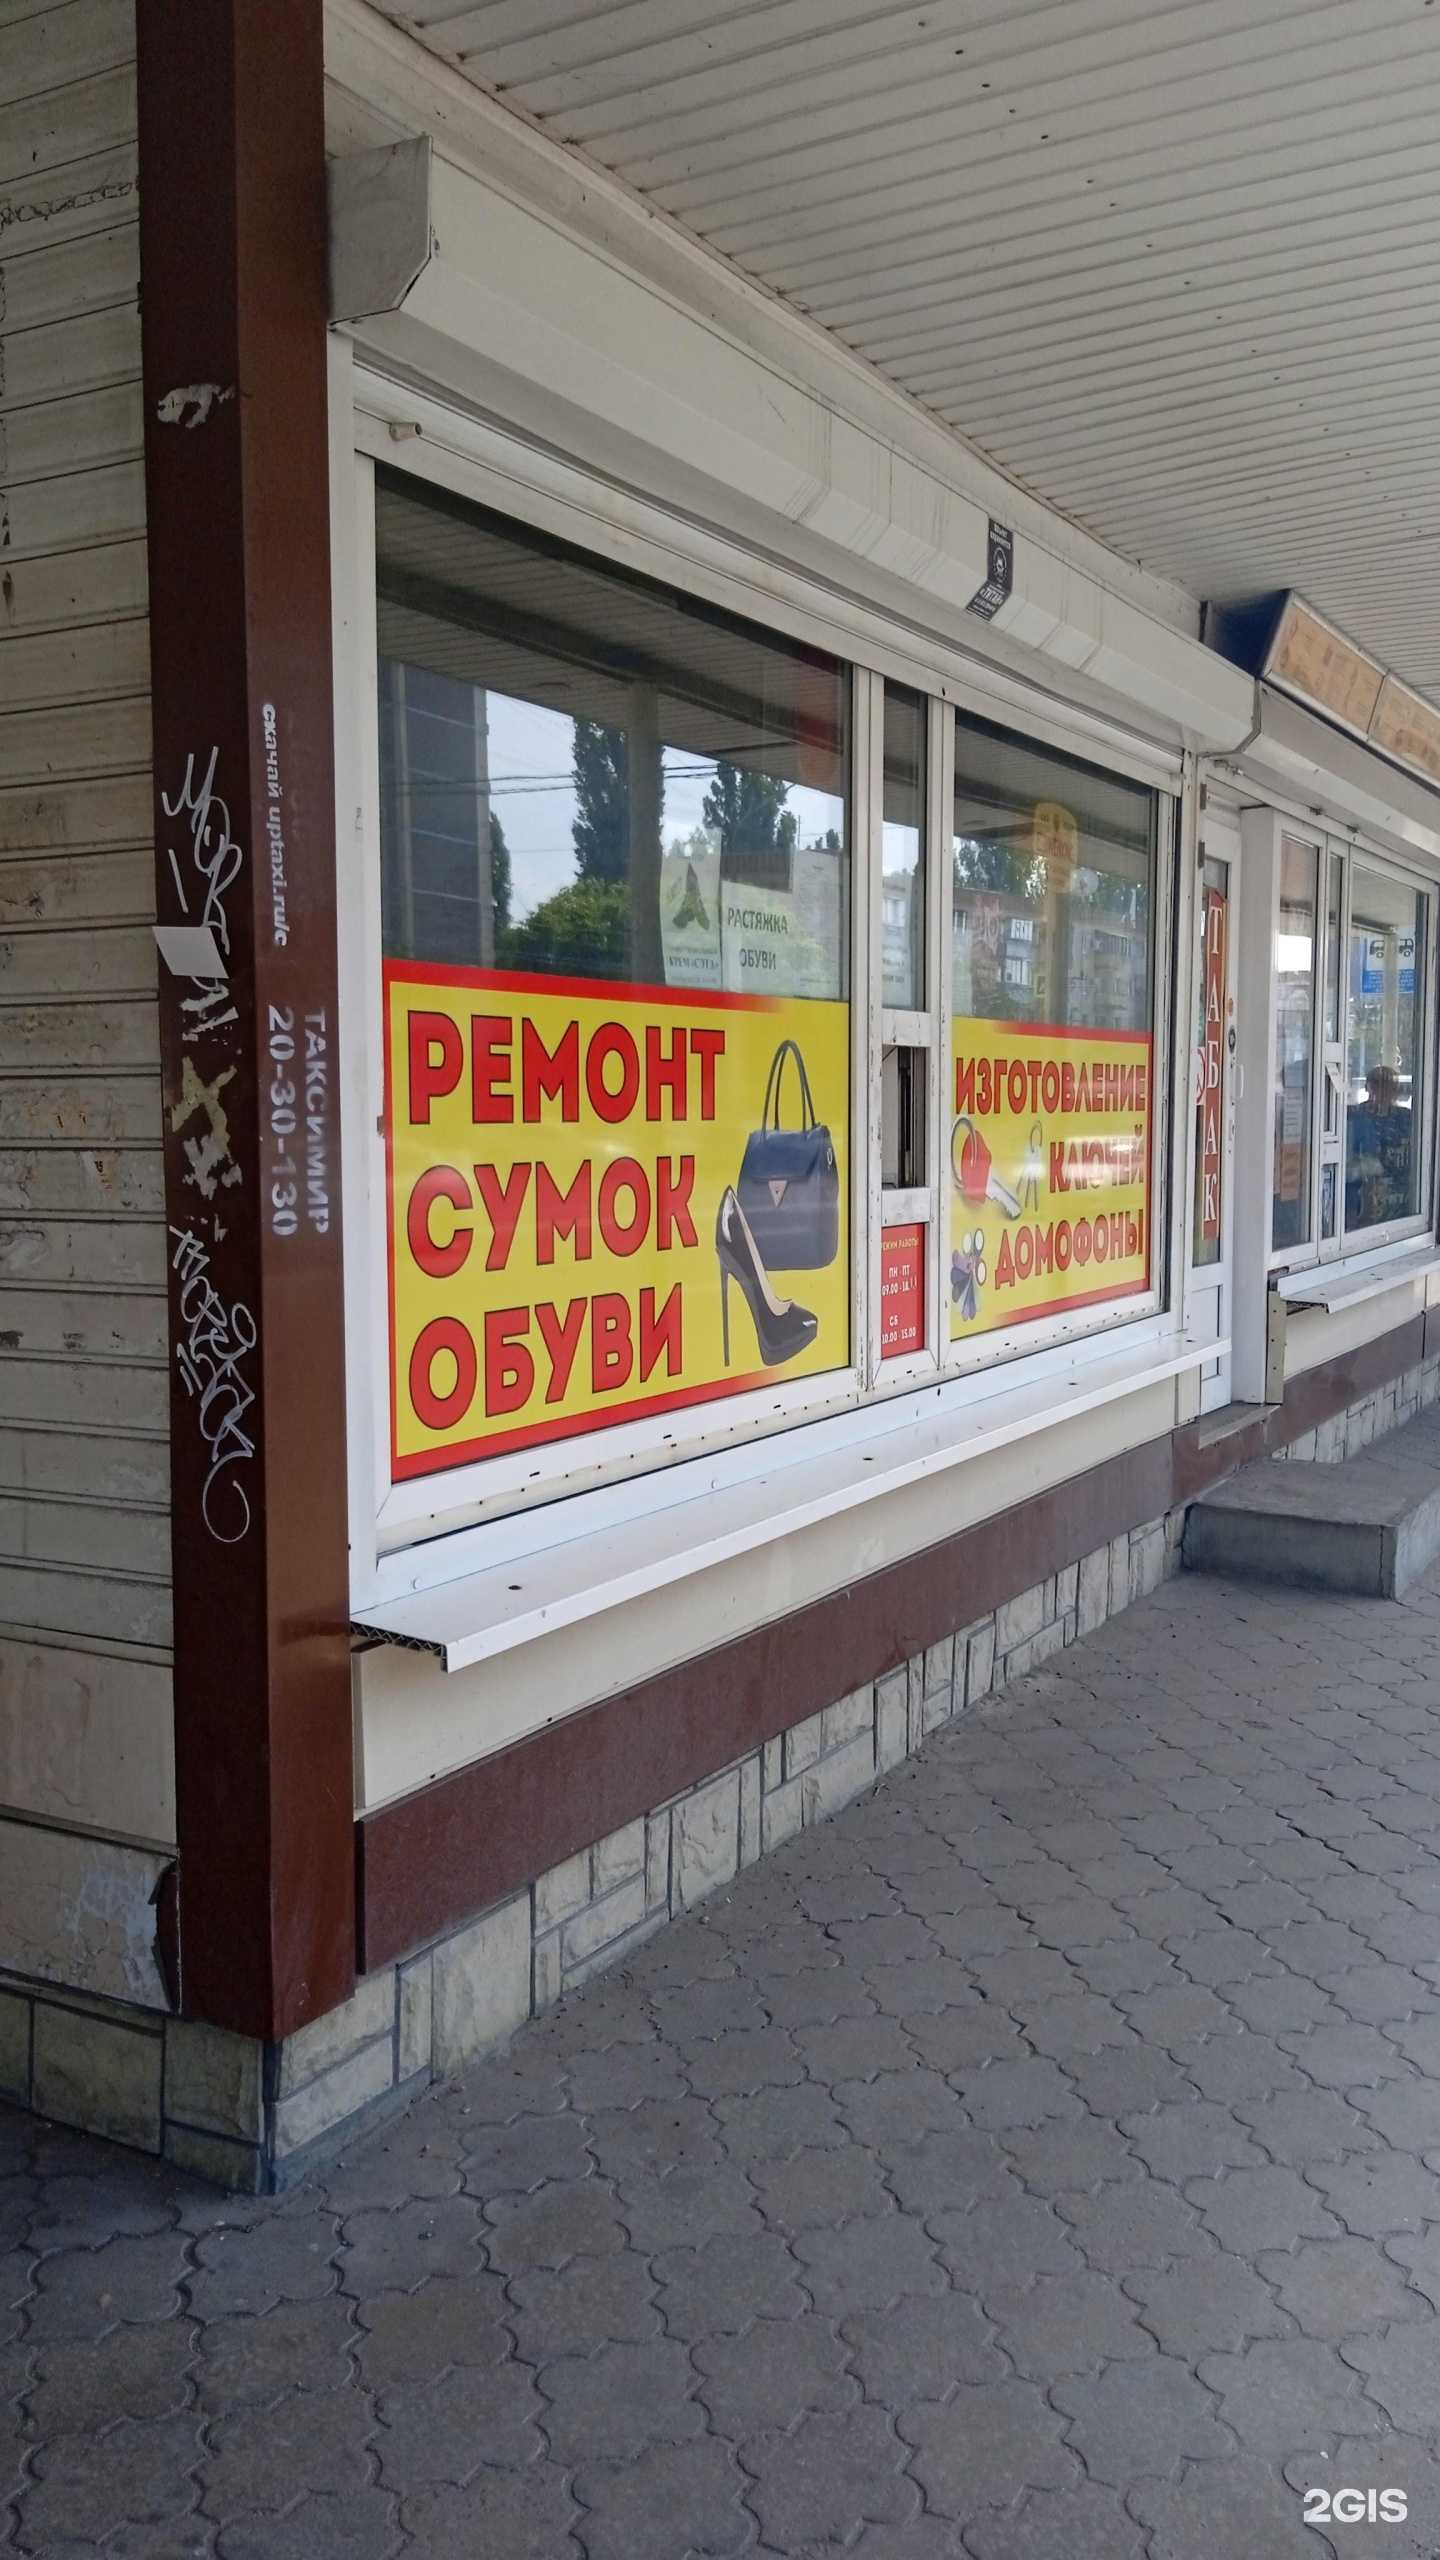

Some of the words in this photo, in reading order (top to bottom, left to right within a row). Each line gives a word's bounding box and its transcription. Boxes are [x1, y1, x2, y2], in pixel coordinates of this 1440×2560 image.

[263, 704, 283, 798] скачай
[728, 908, 788, 934] РАСТЯЖКА
[739, 948, 777, 970] ОБУВИ
[407, 1010, 726, 1125] РЕМОНТ
[955, 1057, 1147, 1115] ИЗГОТОВЛЕНИЕ
[1203, 906, 1222, 1221] ТАБАК
[268, 1004, 298, 1236] 20-30-130
[305, 1007, 329, 1234] ТАКСИМИР
[1049, 1124, 1144, 1193] КЛЮЧЕЙ
[406, 1154, 699, 1279] СУМОК
[994, 1209, 1144, 1291] ДОМОФОНЫ
[408, 1282, 683, 1430] ОБУВИ
